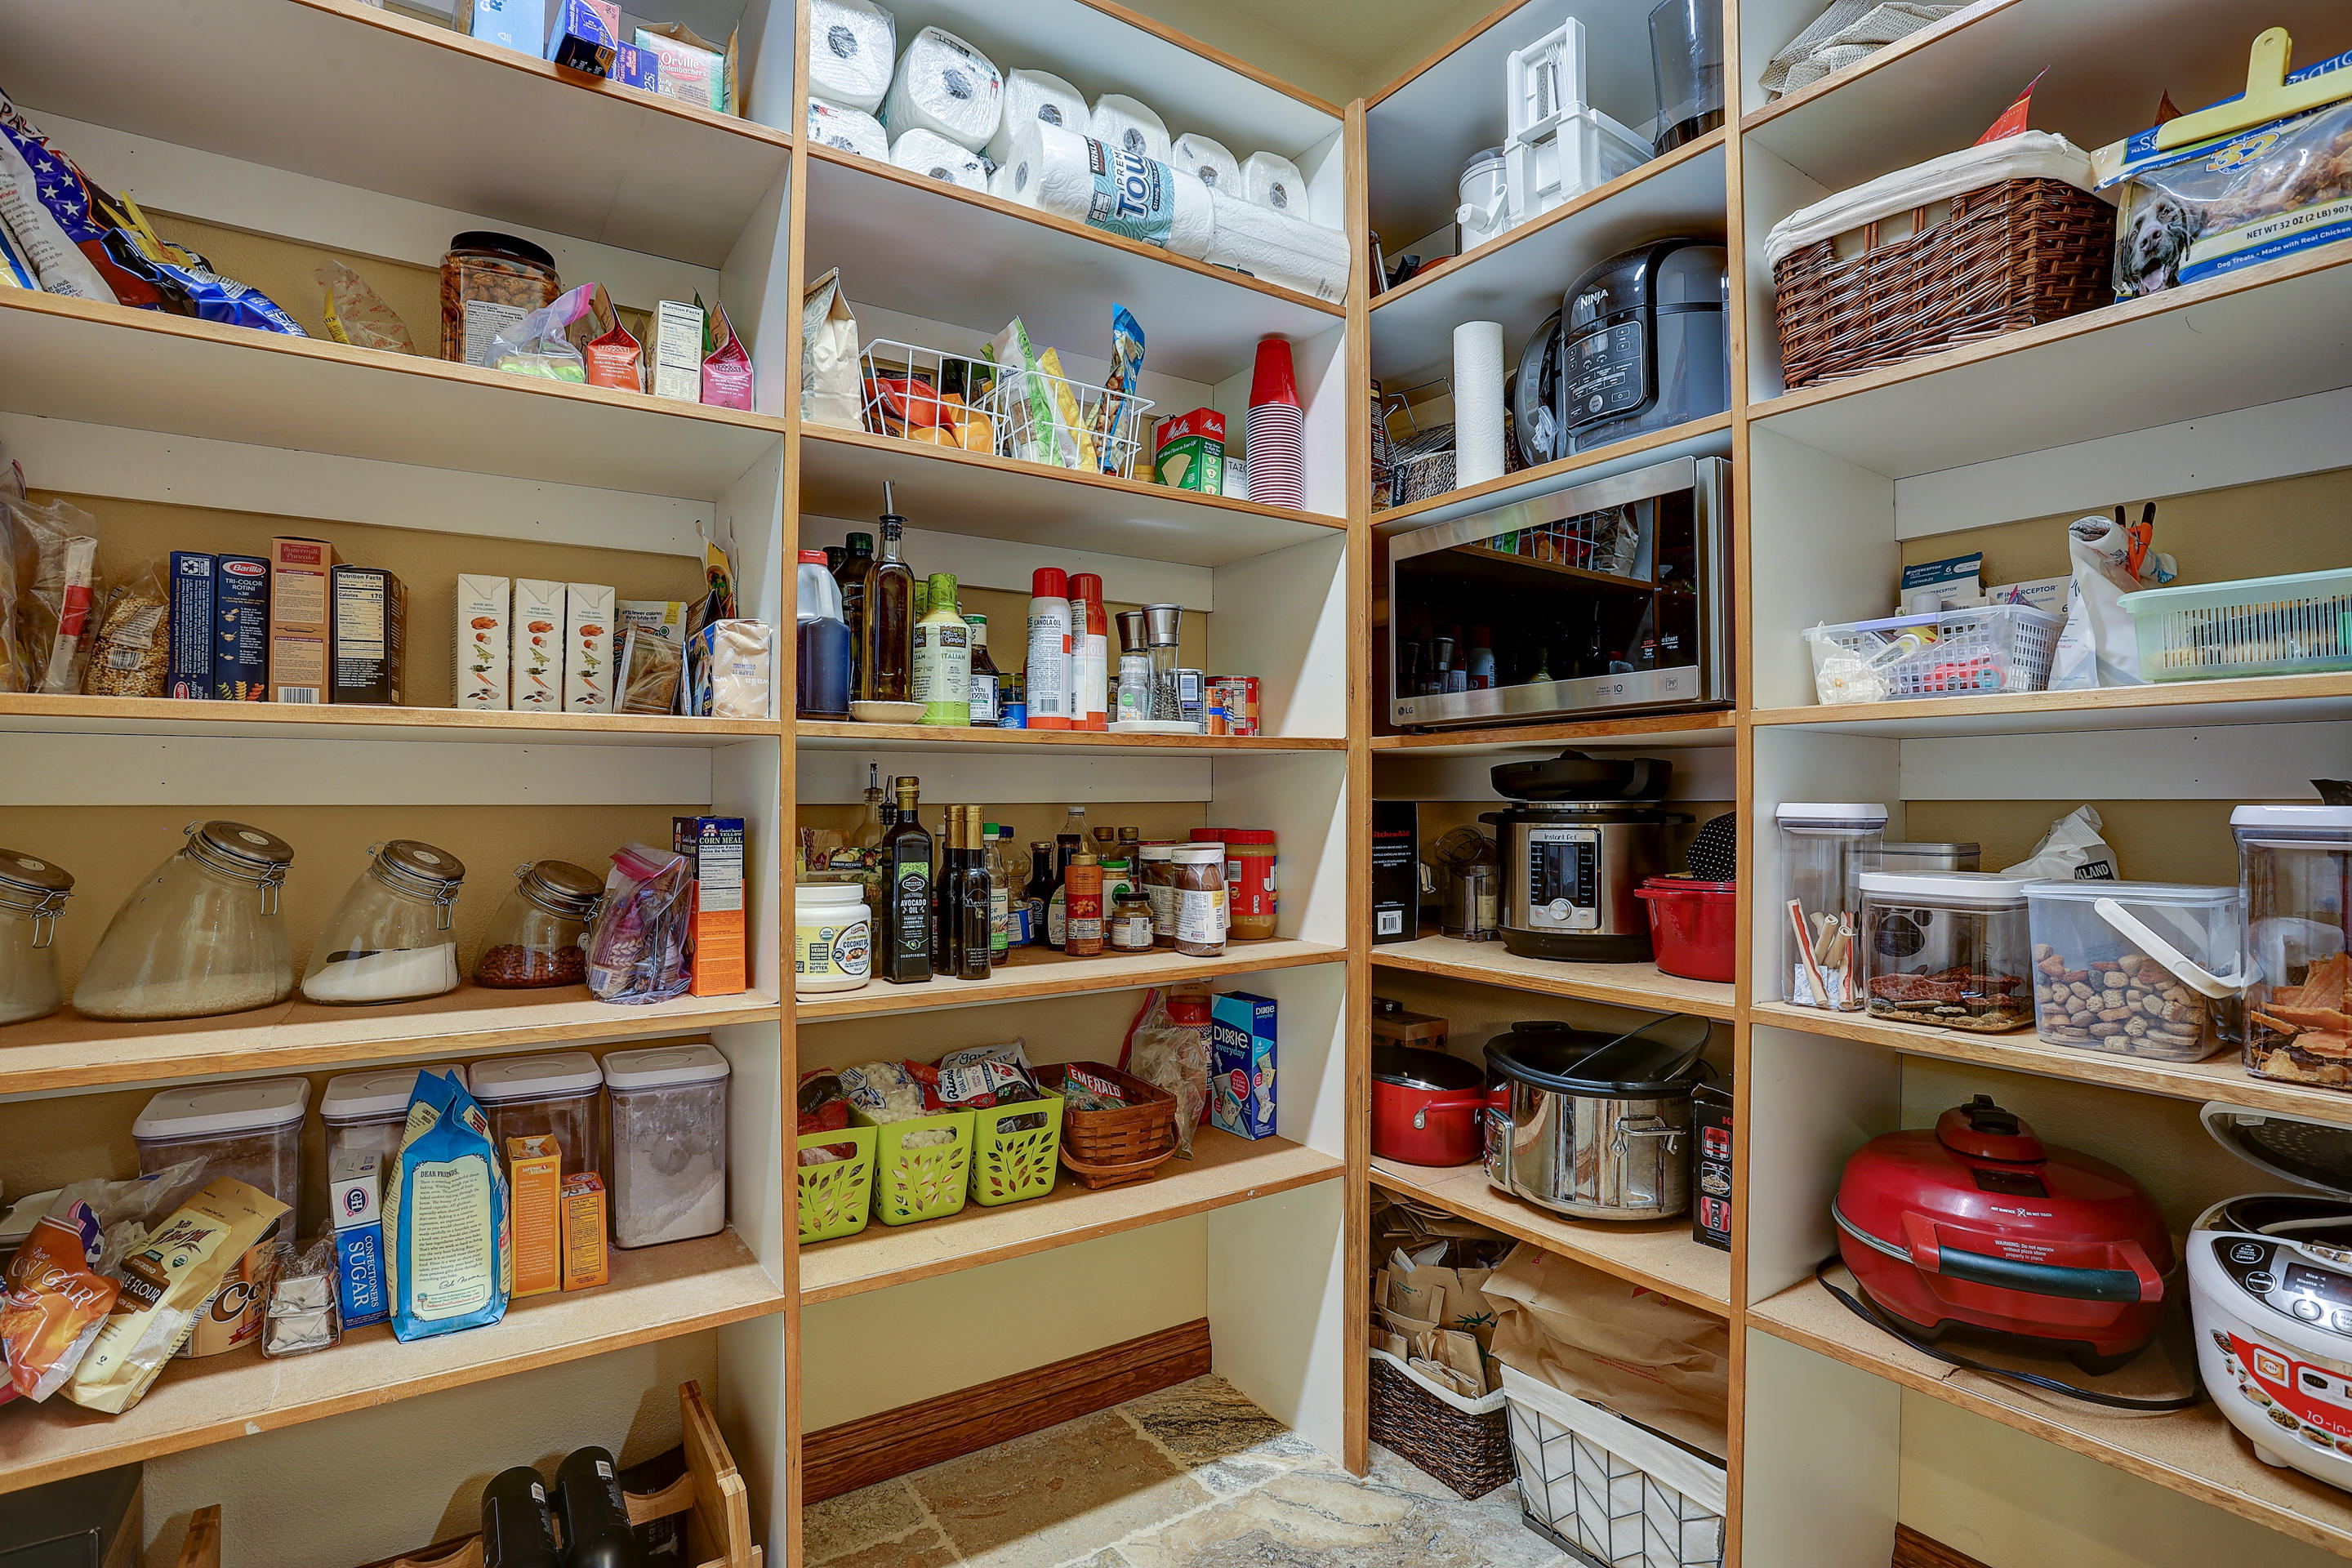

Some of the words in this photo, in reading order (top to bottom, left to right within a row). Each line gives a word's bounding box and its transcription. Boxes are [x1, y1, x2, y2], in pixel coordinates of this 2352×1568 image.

[661, 52, 699, 69] Orville
[2207, 132, 2282, 172] 32
[2247, 229, 2263, 240] NET
[2264, 225, 2278, 235] WT
[2279, 220, 2291, 230] 32
[2292, 216, 2305, 226] OZ
[2305, 213, 2315, 223] (2
[2317, 208, 2332, 219] LB)
[2217, 261, 2231, 270] Dog
[2232, 252, 2255, 264] Treats
[2261, 245, 2282, 256] Made
[2283, 239, 2300, 250] with
[2301, 234, 2319, 244] Real
[2319, 225, 2351, 239] Chicken
[1580, 289, 1609, 310] NINJA
[662, 305, 684, 313] Nutrition
[685, 308, 700, 316] Facts
[1165, 419, 1190, 443] Melitta
[1202, 418, 1224, 434] Melitta
[283, 546, 320, 555] Buttermilk
[287, 553, 315, 561] Pancake
[233, 564, 262, 574] Barilla
[1909, 564, 1943, 575] INTERCEPTOR
[1945, 565, 1952, 573] 6
[225, 577, 263, 586] TRI-COLOR
[1909, 577, 1934, 586] CHEWABLES
[232, 584, 256, 592] ROTINI
[2004, 585, 2056, 599] INERCEPTOR
[2061, 604, 2069, 612] 6
[942, 630, 959, 638] Olive
[176, 684, 185, 700] arilla
[900, 899, 927, 907] AVOCADO
[844, 940, 863, 948] COCONUT
[1215, 1043, 1245, 1059] everyday
[1070, 1066, 1122, 1098] EMERALD
[522, 1165, 542, 1173] SAFEWAY
[1994, 1240, 2020, 1248] WARNING:
[348, 1241, 369, 1308] SUGAR
[364, 1235, 379, 1307] CONFECTIONERS
[23, 1255, 96, 1311] SUGAR
[2248, 1278, 2272, 1286] Browning
[129, 1280, 162, 1303] FLOUR
